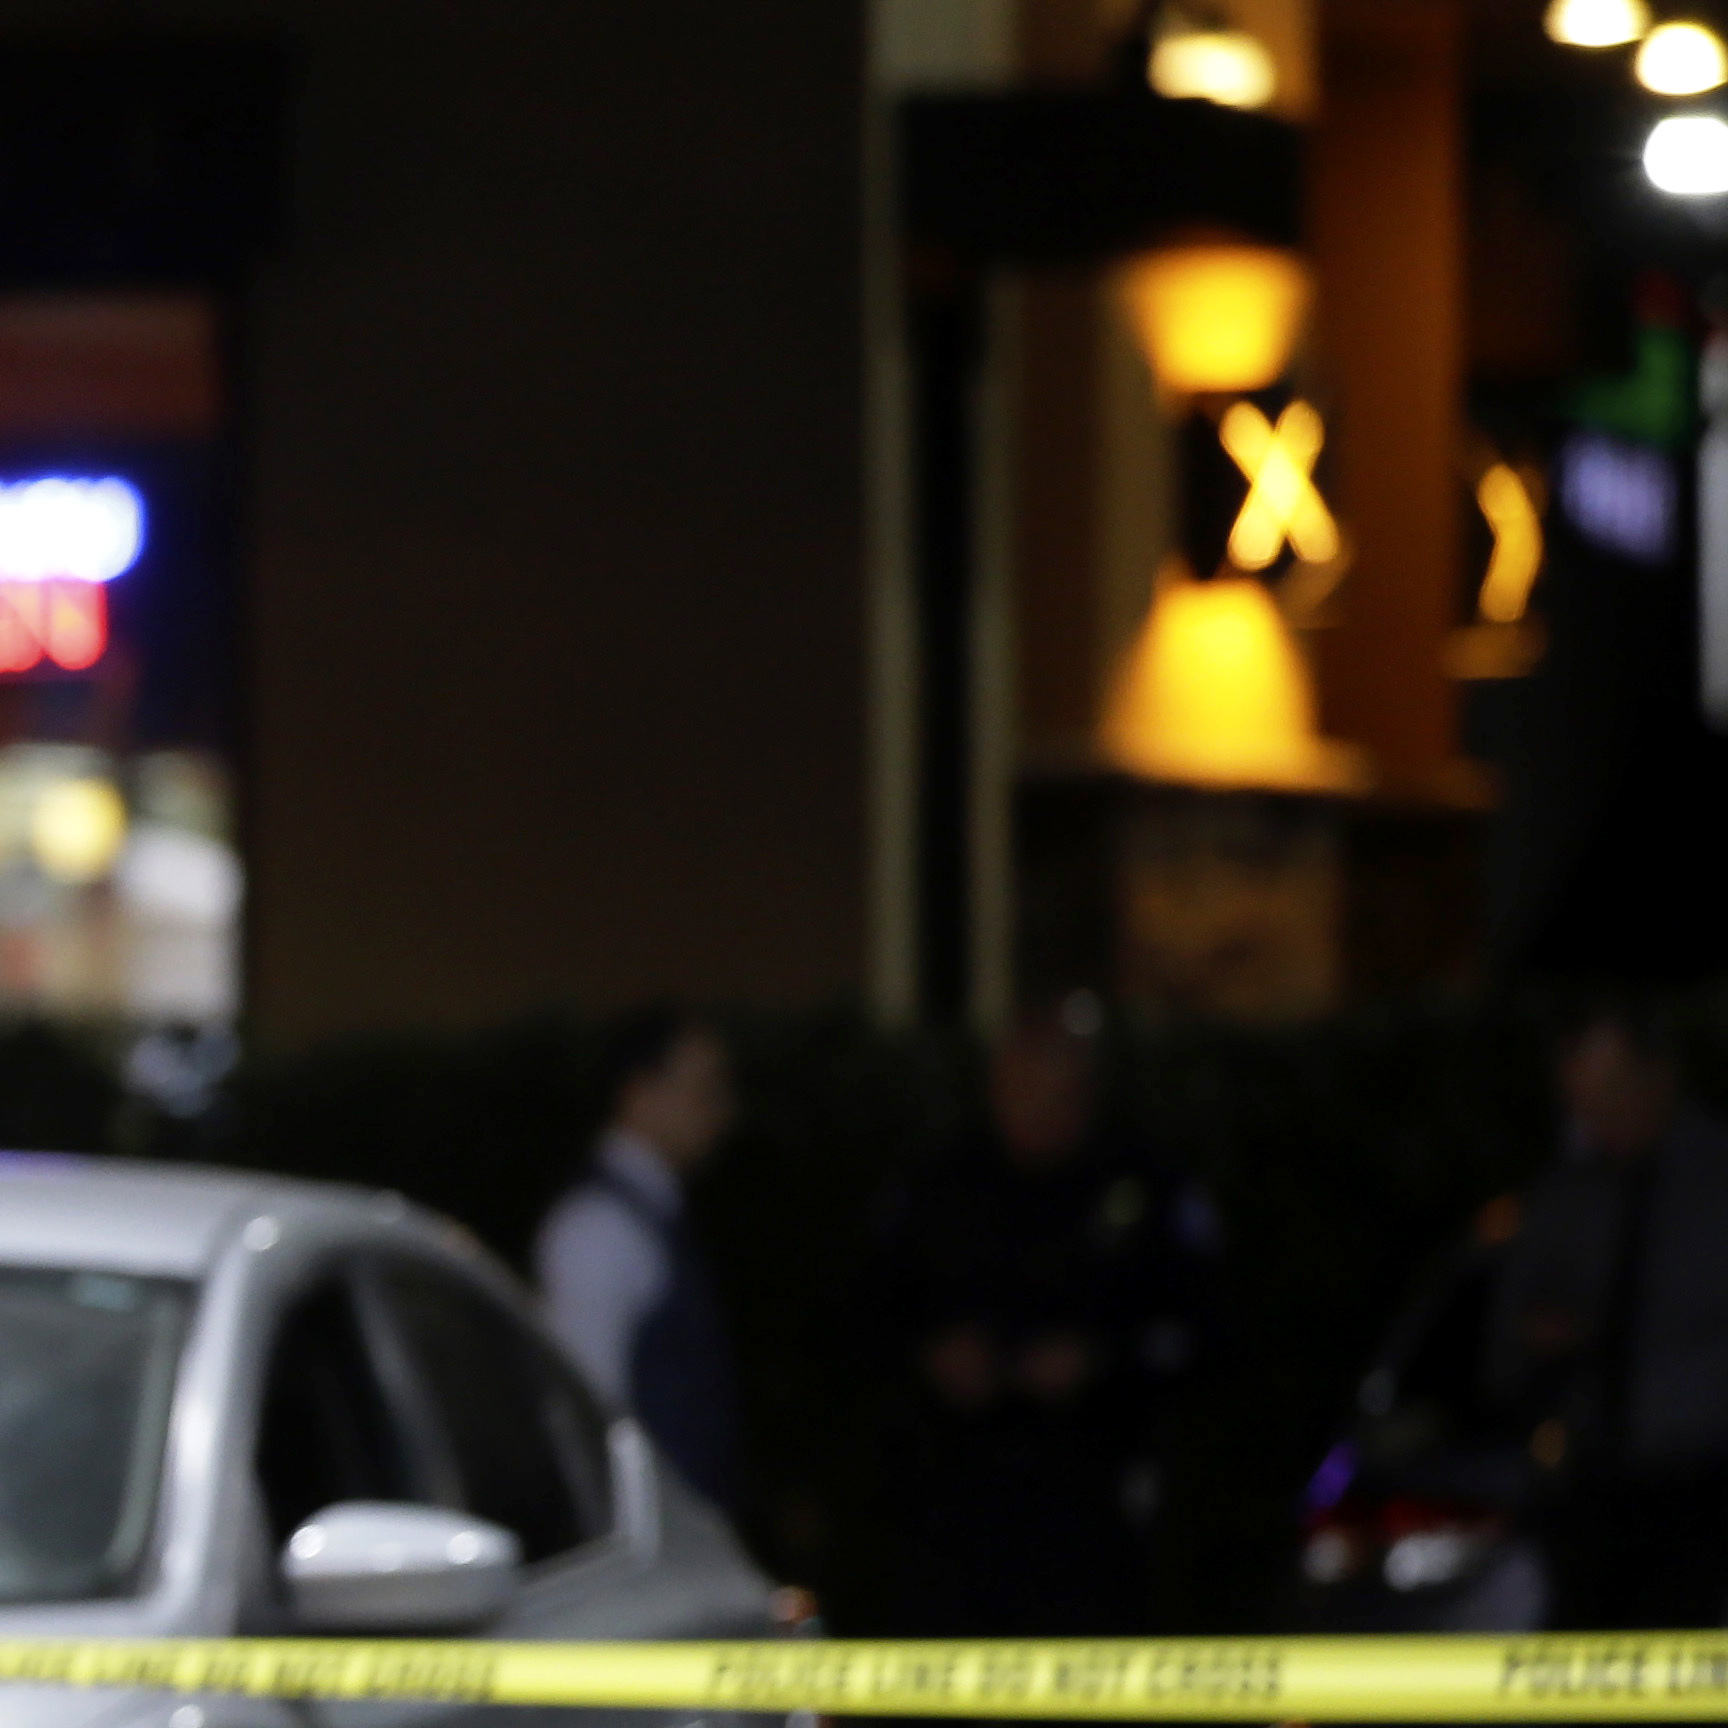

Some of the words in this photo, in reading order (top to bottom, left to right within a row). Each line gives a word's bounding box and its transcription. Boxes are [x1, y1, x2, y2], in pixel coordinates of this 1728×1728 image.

[702, 1645, 850, 1702] POLICE
[862, 1647, 960, 1703] LINE
[974, 1648, 1040, 1704] DO
[1047, 1648, 1136, 1704] NOT
[1145, 1648, 1284, 1704] CROSS
[1499, 1640, 1649, 1700] POLICE
